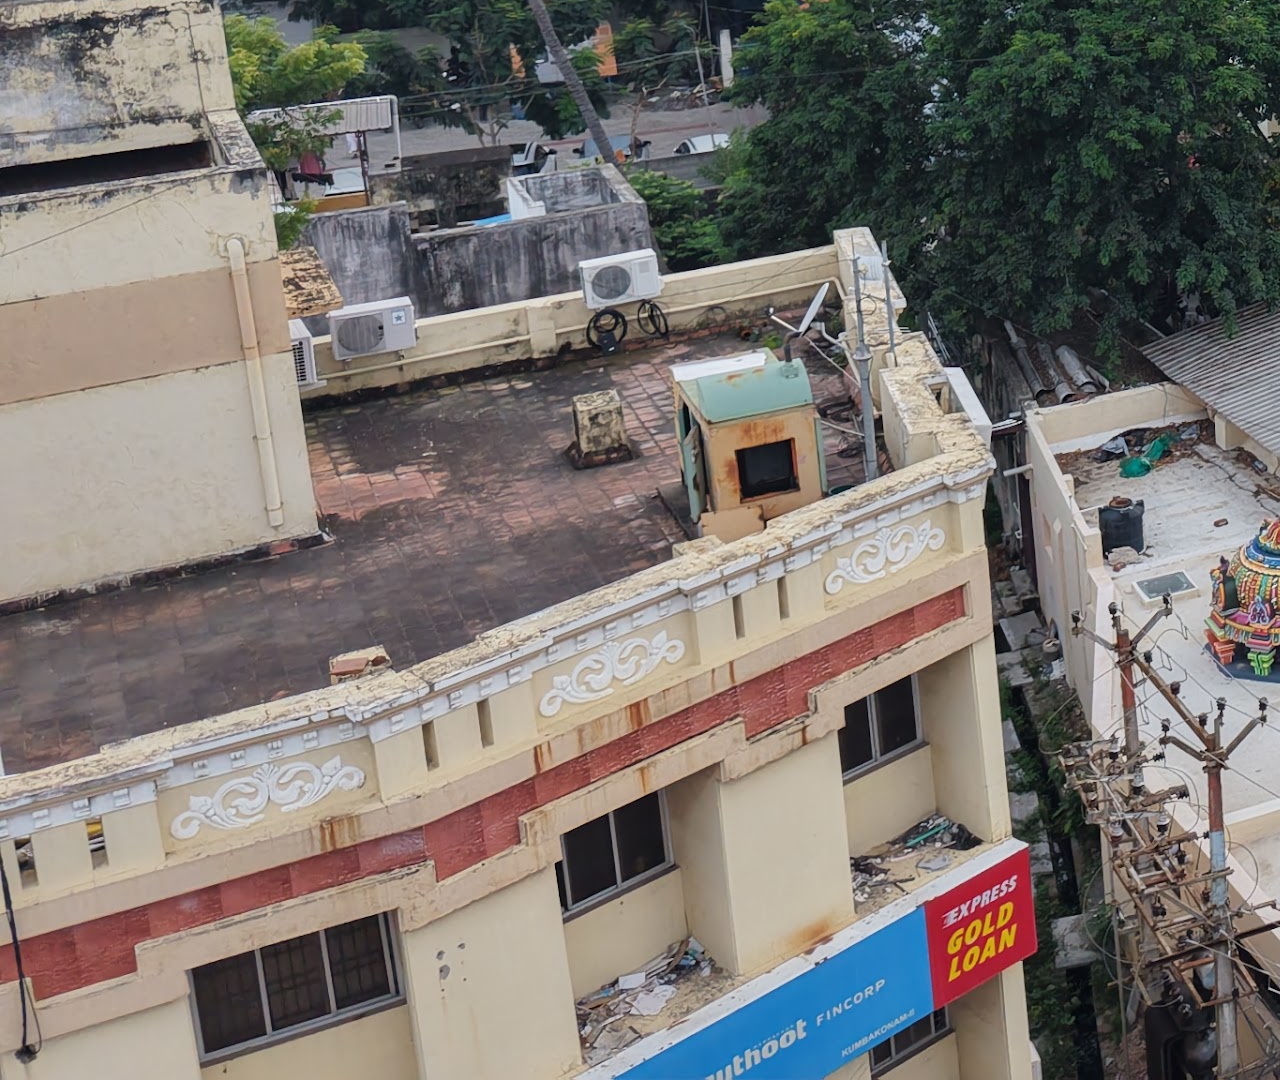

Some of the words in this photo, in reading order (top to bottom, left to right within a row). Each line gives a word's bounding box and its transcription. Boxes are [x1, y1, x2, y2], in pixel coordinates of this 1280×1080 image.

[942, 875, 1018, 929] EXPRESS
[947, 901, 1014, 955] GOLD
[948, 923, 1018, 983] LOAN
[704, 1019, 807, 1080] uthoot
[816, 978, 886, 1027] FINCORP
